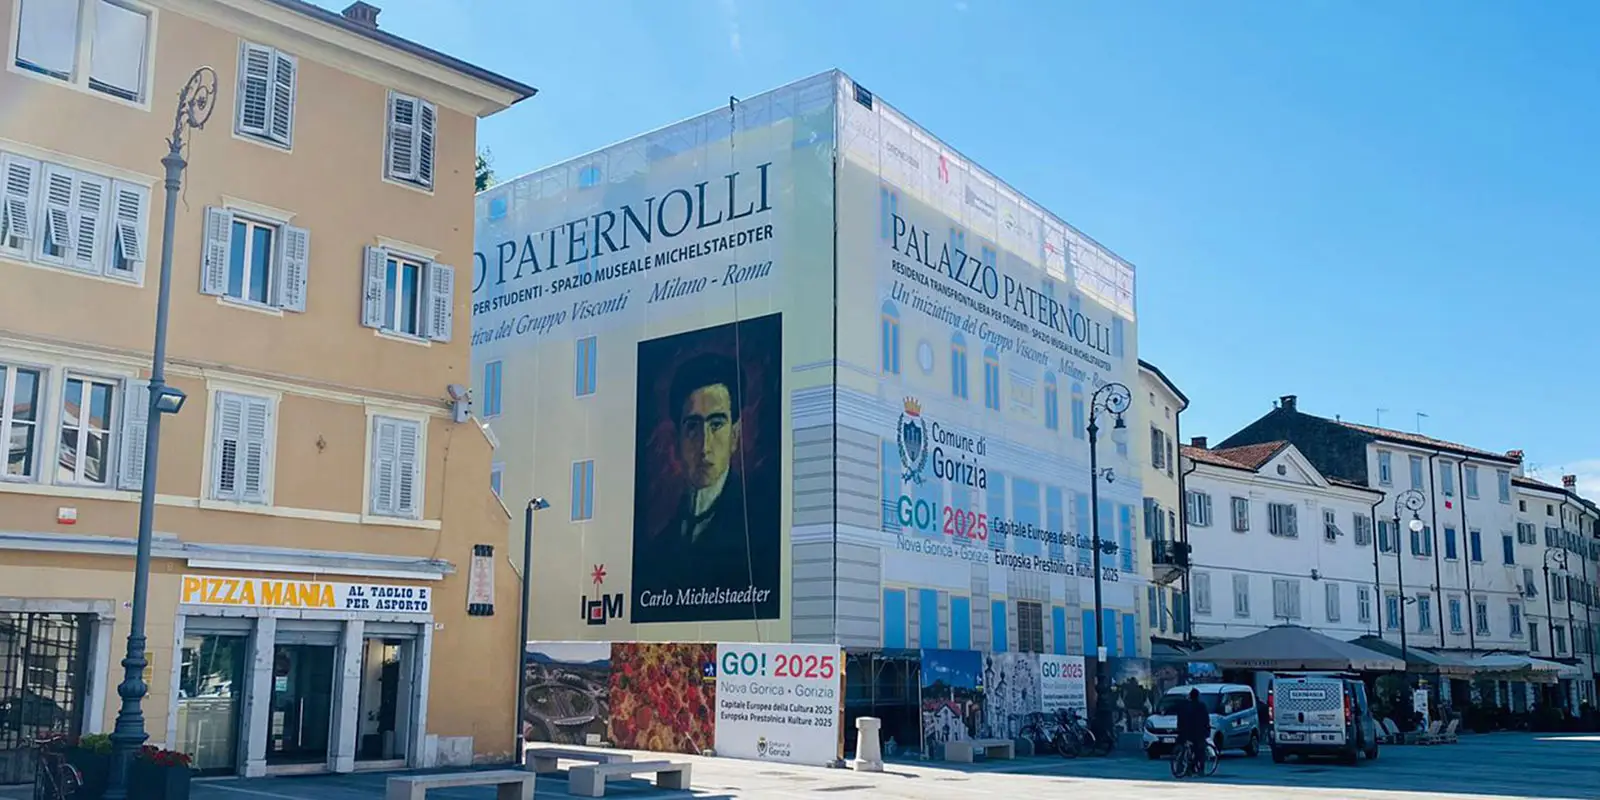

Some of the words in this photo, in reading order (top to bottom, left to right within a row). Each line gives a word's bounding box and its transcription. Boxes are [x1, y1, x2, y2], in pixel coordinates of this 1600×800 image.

[496, 162, 773, 285] PATERNOLLI
[473, 300, 490, 316] PER
[492, 285, 542, 310] STUDENTI
[551, 271, 592, 294] SPAZIO
[594, 256, 652, 282] MUSEALE
[653, 224, 774, 267] MICHELSTAEDTER
[891, 213, 999, 300] PALAZZO
[1003, 274, 1112, 356] PATERNOLLI
[494, 318, 515, 342] del
[515, 310, 567, 335] Gruppo
[571, 290, 632, 322] Visconti
[647, 274, 707, 304] Milano
[721, 260, 773, 287] Roma
[892, 259, 930, 289] RESIDENZA
[929, 278, 989, 317] TRANSFRONTALIERA
[990, 308, 1003, 321] PER
[1002, 313, 1029, 335] STUDENTI
[891, 280, 962, 328] Un'iniziativa
[962, 314, 977, 335] del
[979, 322, 1014, 354] Gruppo
[1015, 336, 1050, 367] Visconti
[931, 421, 974, 453] Comune
[976, 436, 987, 457] di
[932, 446, 987, 490] Gorizia
[897, 495, 937, 532] GO!
[943, 505, 988, 541] 2025
[993, 517, 1026, 539] Capitale
[1027, 523, 1058, 546] Europea
[1058, 530, 1076, 547] della
[897, 534, 923, 554] Nova
[923, 538, 953, 558] Gorica
[994, 549, 1032, 571] Evropska
[1033, 555, 1075, 576] Prestolnica
[1102, 566, 1119, 582] 2025
[182, 577, 256, 605] PIZZA
[261, 580, 336, 608] MANIA
[346, 598, 370, 609] PER
[375, 599, 428, 611] ASPORTO
[349, 585, 365, 597] AL
[370, 586, 413, 599] TAGLIO
[419, 589, 427, 599] E
[640, 590, 673, 607] Carlo
[676, 585, 771, 606] Michelstaedter
[722, 651, 766, 676] GO!
[774, 654, 834, 679] 2025
[1042, 662, 1060, 678] GO!
[1062, 663, 1083, 678] 2025
[721, 682, 747, 694] Nova
[749, 682, 784, 696] Gorica
[795, 684, 834, 699] Gorizia
[721, 699, 746, 711] Capitale
[746, 701, 772, 713] Europea
[773, 703, 788, 712] della
[789, 704, 813, 714] Cultura
[815, 705, 833, 715] 2025
[721, 711, 749, 722] Evropska
[750, 713, 785, 724] Prestolnica
[788, 716, 812, 726] Kulture
[814, 717, 833, 727] 2025
